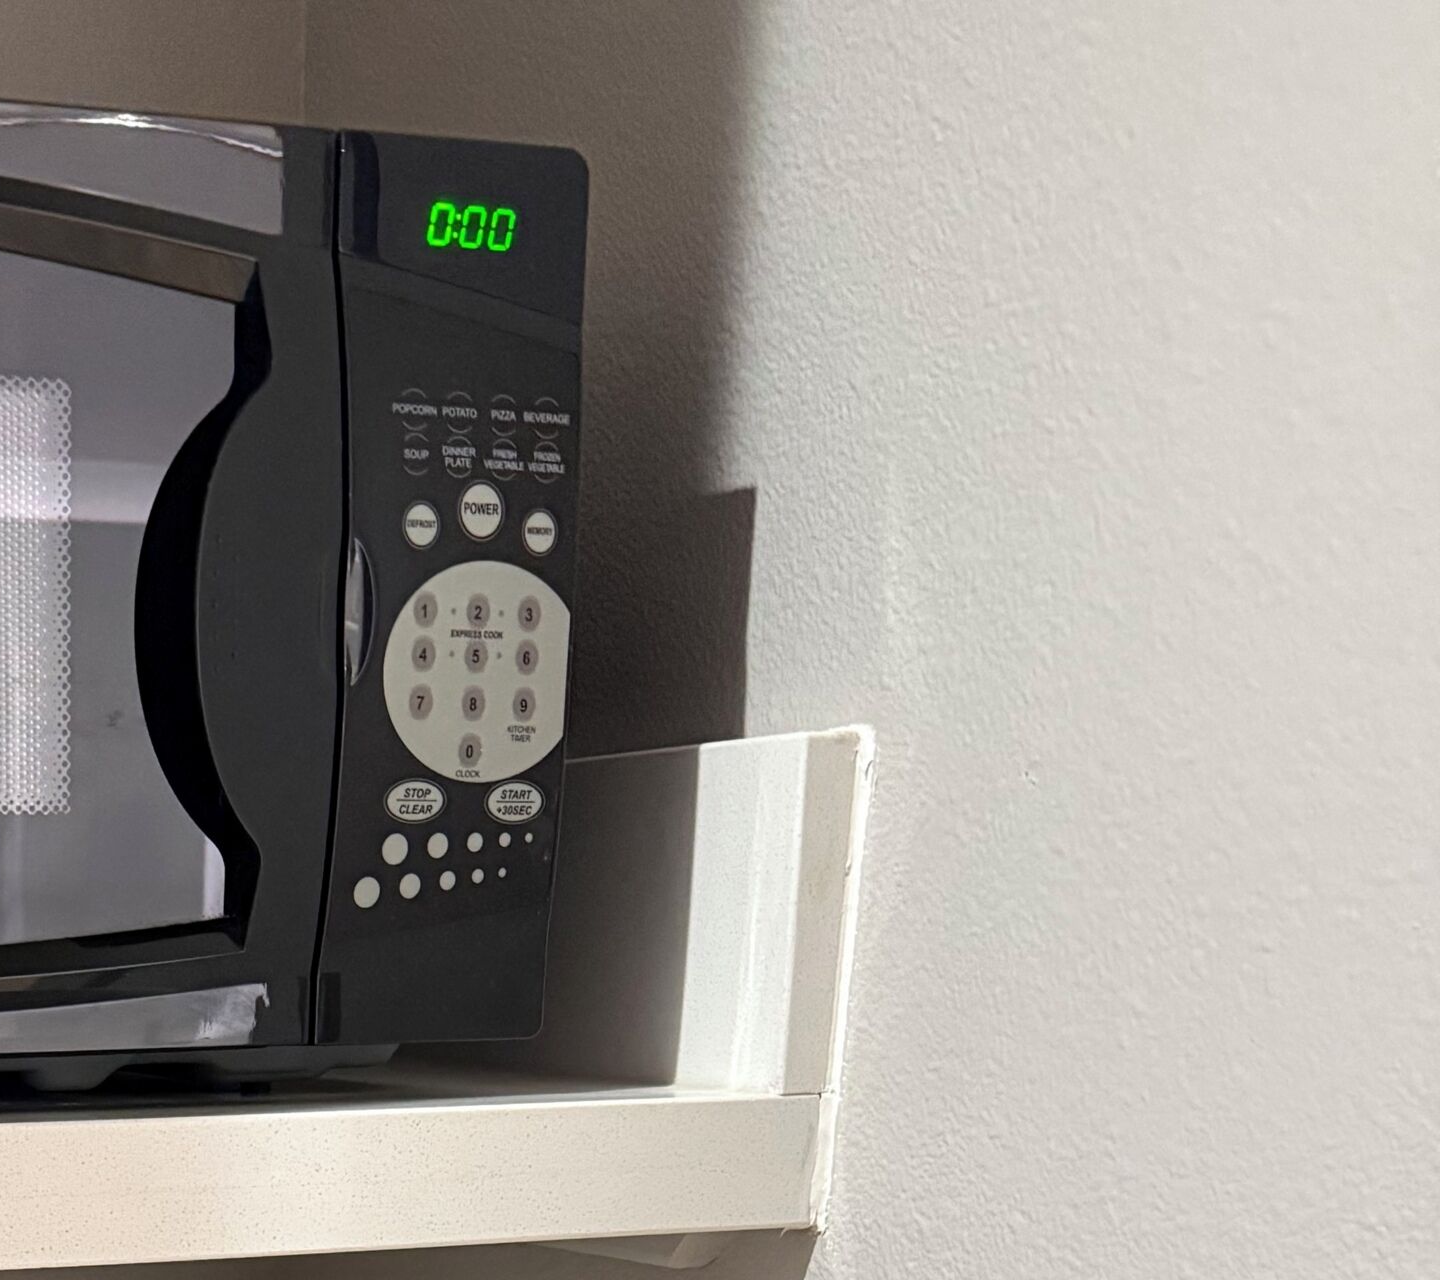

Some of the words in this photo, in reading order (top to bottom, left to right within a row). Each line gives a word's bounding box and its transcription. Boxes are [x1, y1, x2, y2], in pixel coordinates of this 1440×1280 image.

[427, 202, 516, 251] 0:00
[392, 402, 438, 416] POPCORN
[442, 405, 478, 419] POTATO
[491, 409, 517, 422] PIZZA
[523, 411, 571, 426] BEVERAGE
[403, 448, 430, 460] SOUP
[442, 445, 476, 457] DINNER
[492, 448, 518, 459] FRESH
[534, 451, 561, 462] FROZEN
[445, 457, 472, 468] PLATE
[484, 459, 524, 472] VEGETABLE
[527, 462, 566, 474] VEGETABLE
[463, 501, 500, 516] POWER
[407, 519, 437, 529] DEFROST
[526, 526, 553, 536] MEMORY
[422, 604, 428, 618] 1
[474, 605, 483, 620] 2
[524, 607, 533, 622] 3
[450, 629, 482, 639] EXPRESS
[484, 630, 503, 640] COOK
[418, 647, 427, 661] 4
[471, 650, 480, 664] 5
[522, 651, 531, 665] 6
[416, 696, 424, 710] 7
[469, 697, 477, 712] 8
[520, 699, 528, 713] 9
[507, 725, 536, 735] KITCHEN
[510, 734, 531, 743] TIMER
[465, 745, 473, 759] 0
[456, 770, 480, 778] CLOCK
[403, 787, 432, 799] STOP
[500, 789, 533, 800] START
[398, 804, 433, 816] CLEAR
[496, 805, 533, 816] +30SEC
